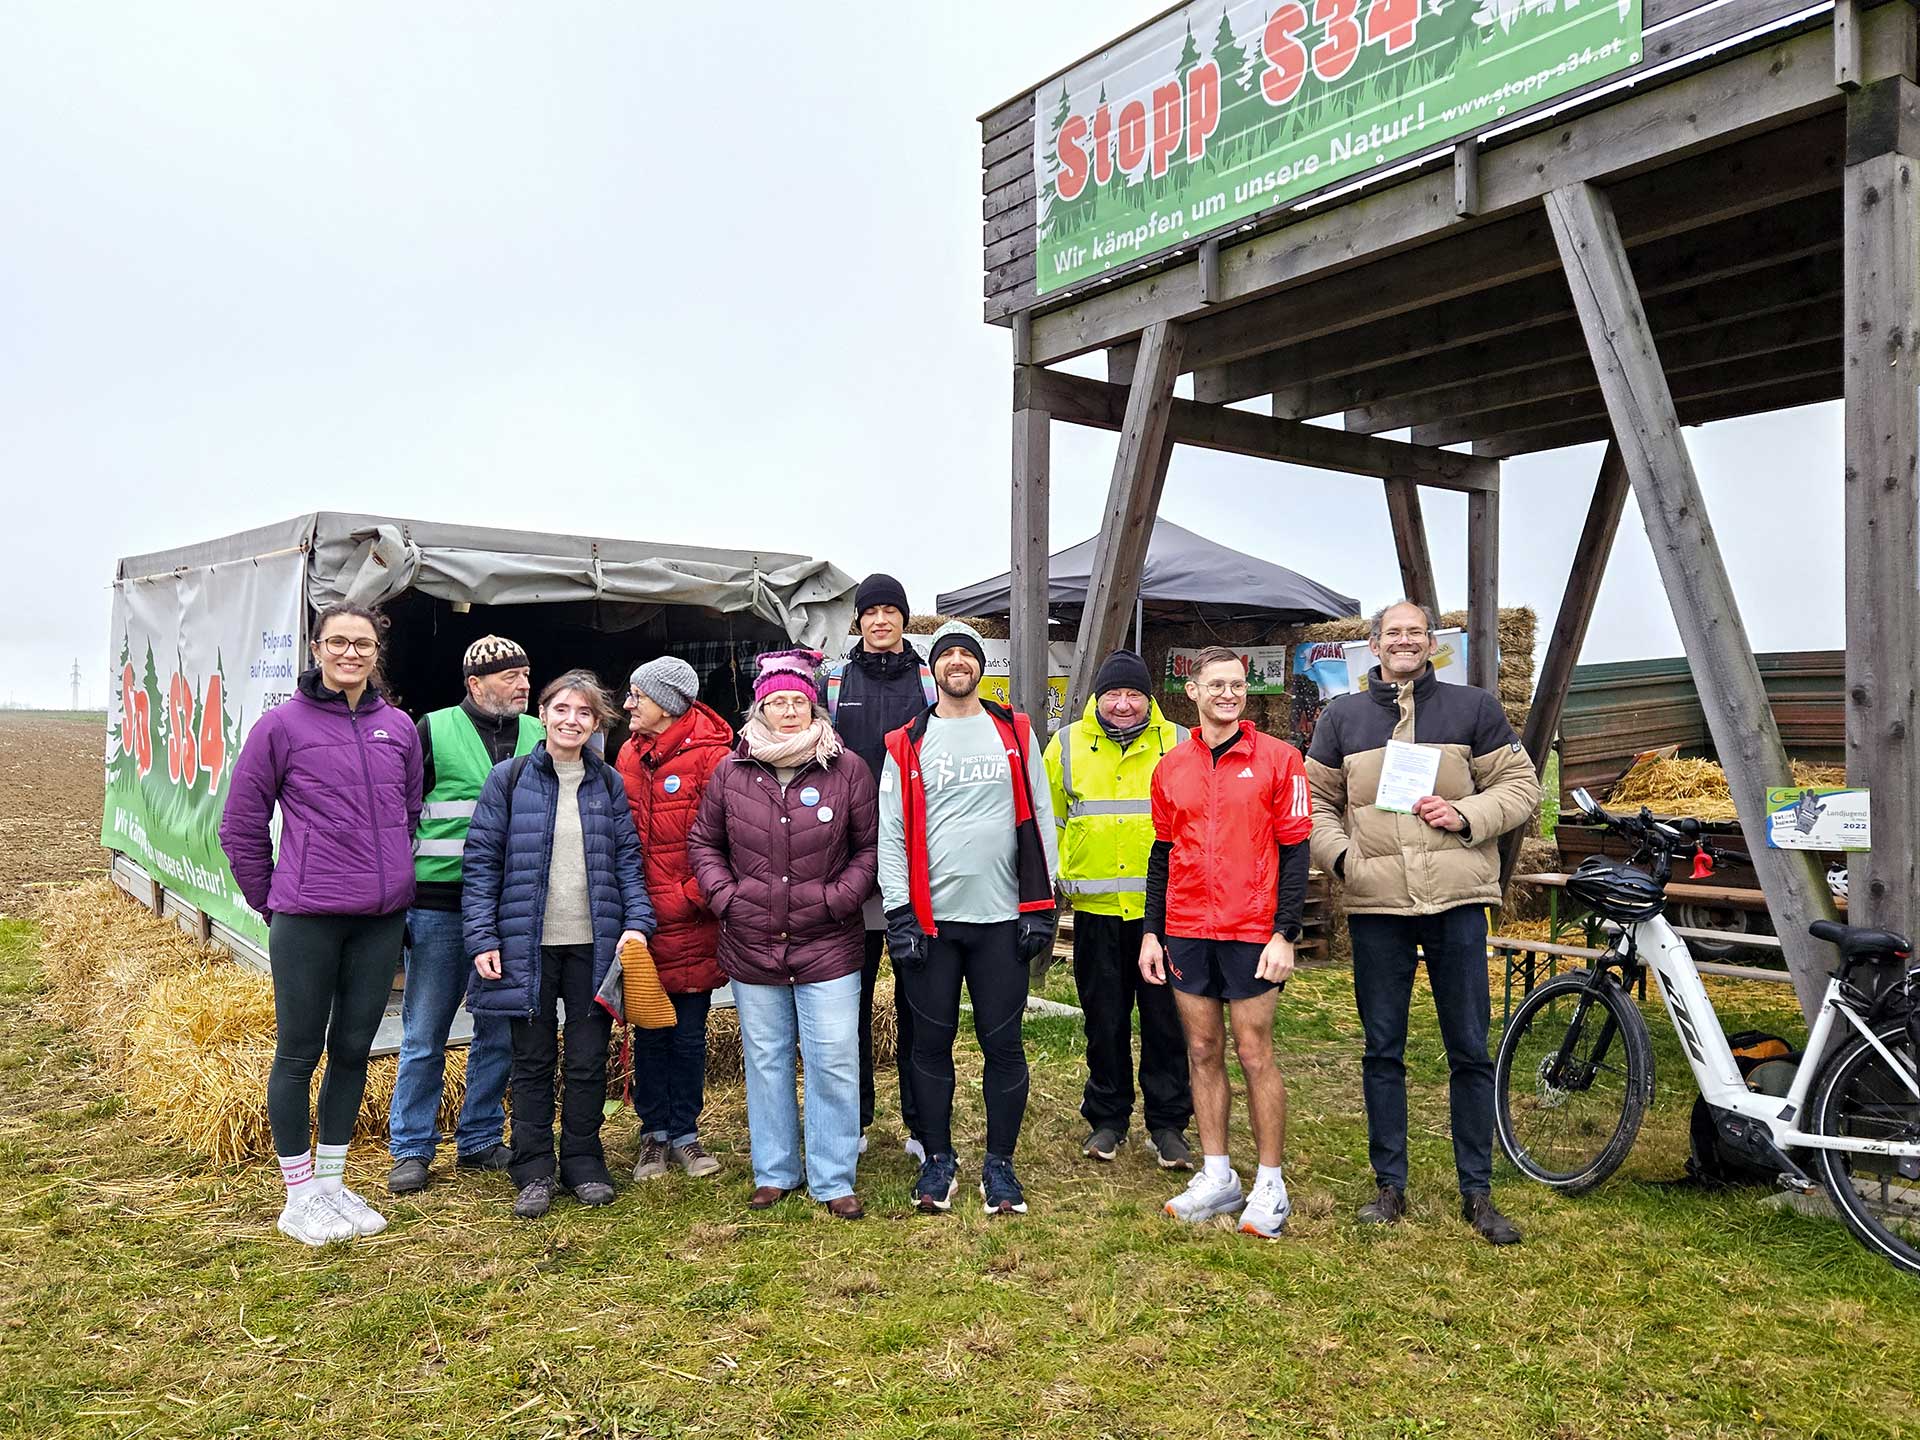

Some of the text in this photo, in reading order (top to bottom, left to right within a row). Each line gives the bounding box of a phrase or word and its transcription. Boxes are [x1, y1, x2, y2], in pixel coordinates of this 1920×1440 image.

[1056, 0, 1420, 199] Stopp S34
[1439, 37, 1622, 122] www.stopp-s34.at
[1053, 101, 1426, 274] Wir kämpfen um unsere Natur!
[959, 762, 1006, 782] LAUF
[182, 855, 227, 899] Natur!
[1657, 968, 1707, 1066] KTM
